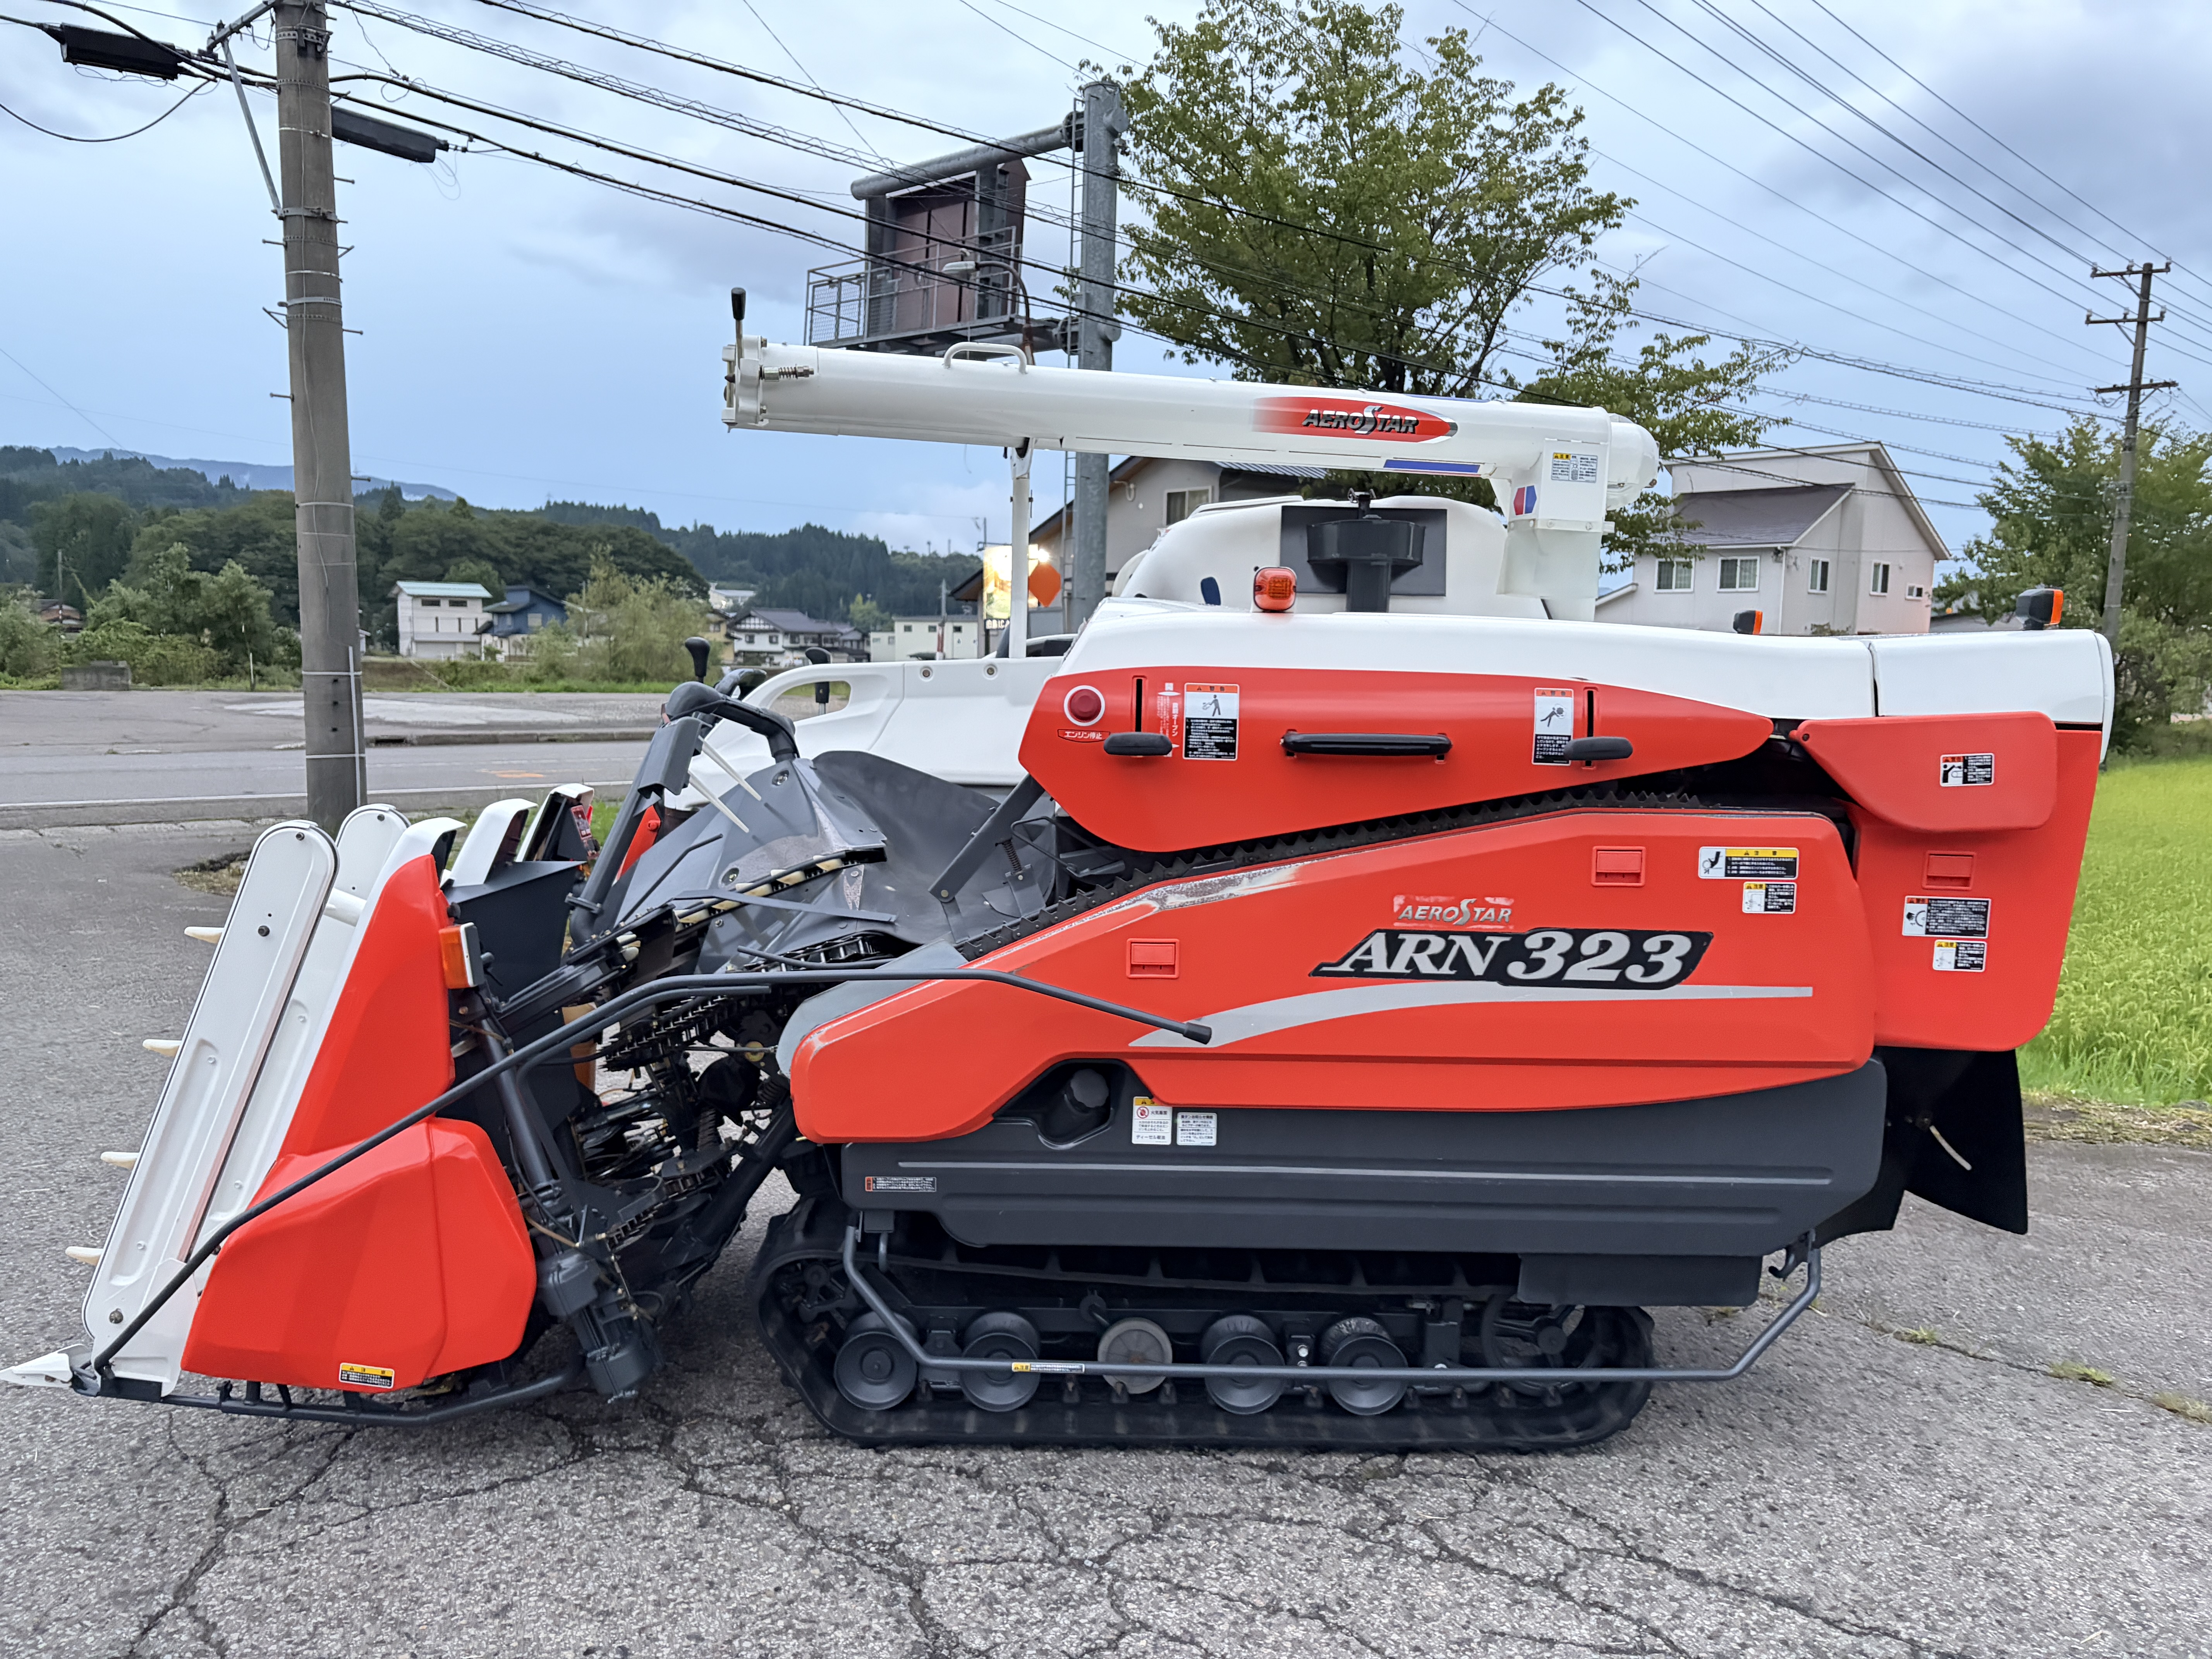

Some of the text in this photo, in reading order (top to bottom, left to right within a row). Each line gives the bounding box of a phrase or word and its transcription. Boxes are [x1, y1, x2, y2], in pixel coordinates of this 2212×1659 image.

[1302, 405, 1419, 435] AEROSTAR
[1398, 898, 1511, 925] AEROSTAR
[1319, 931, 1692, 983] ARN 323
